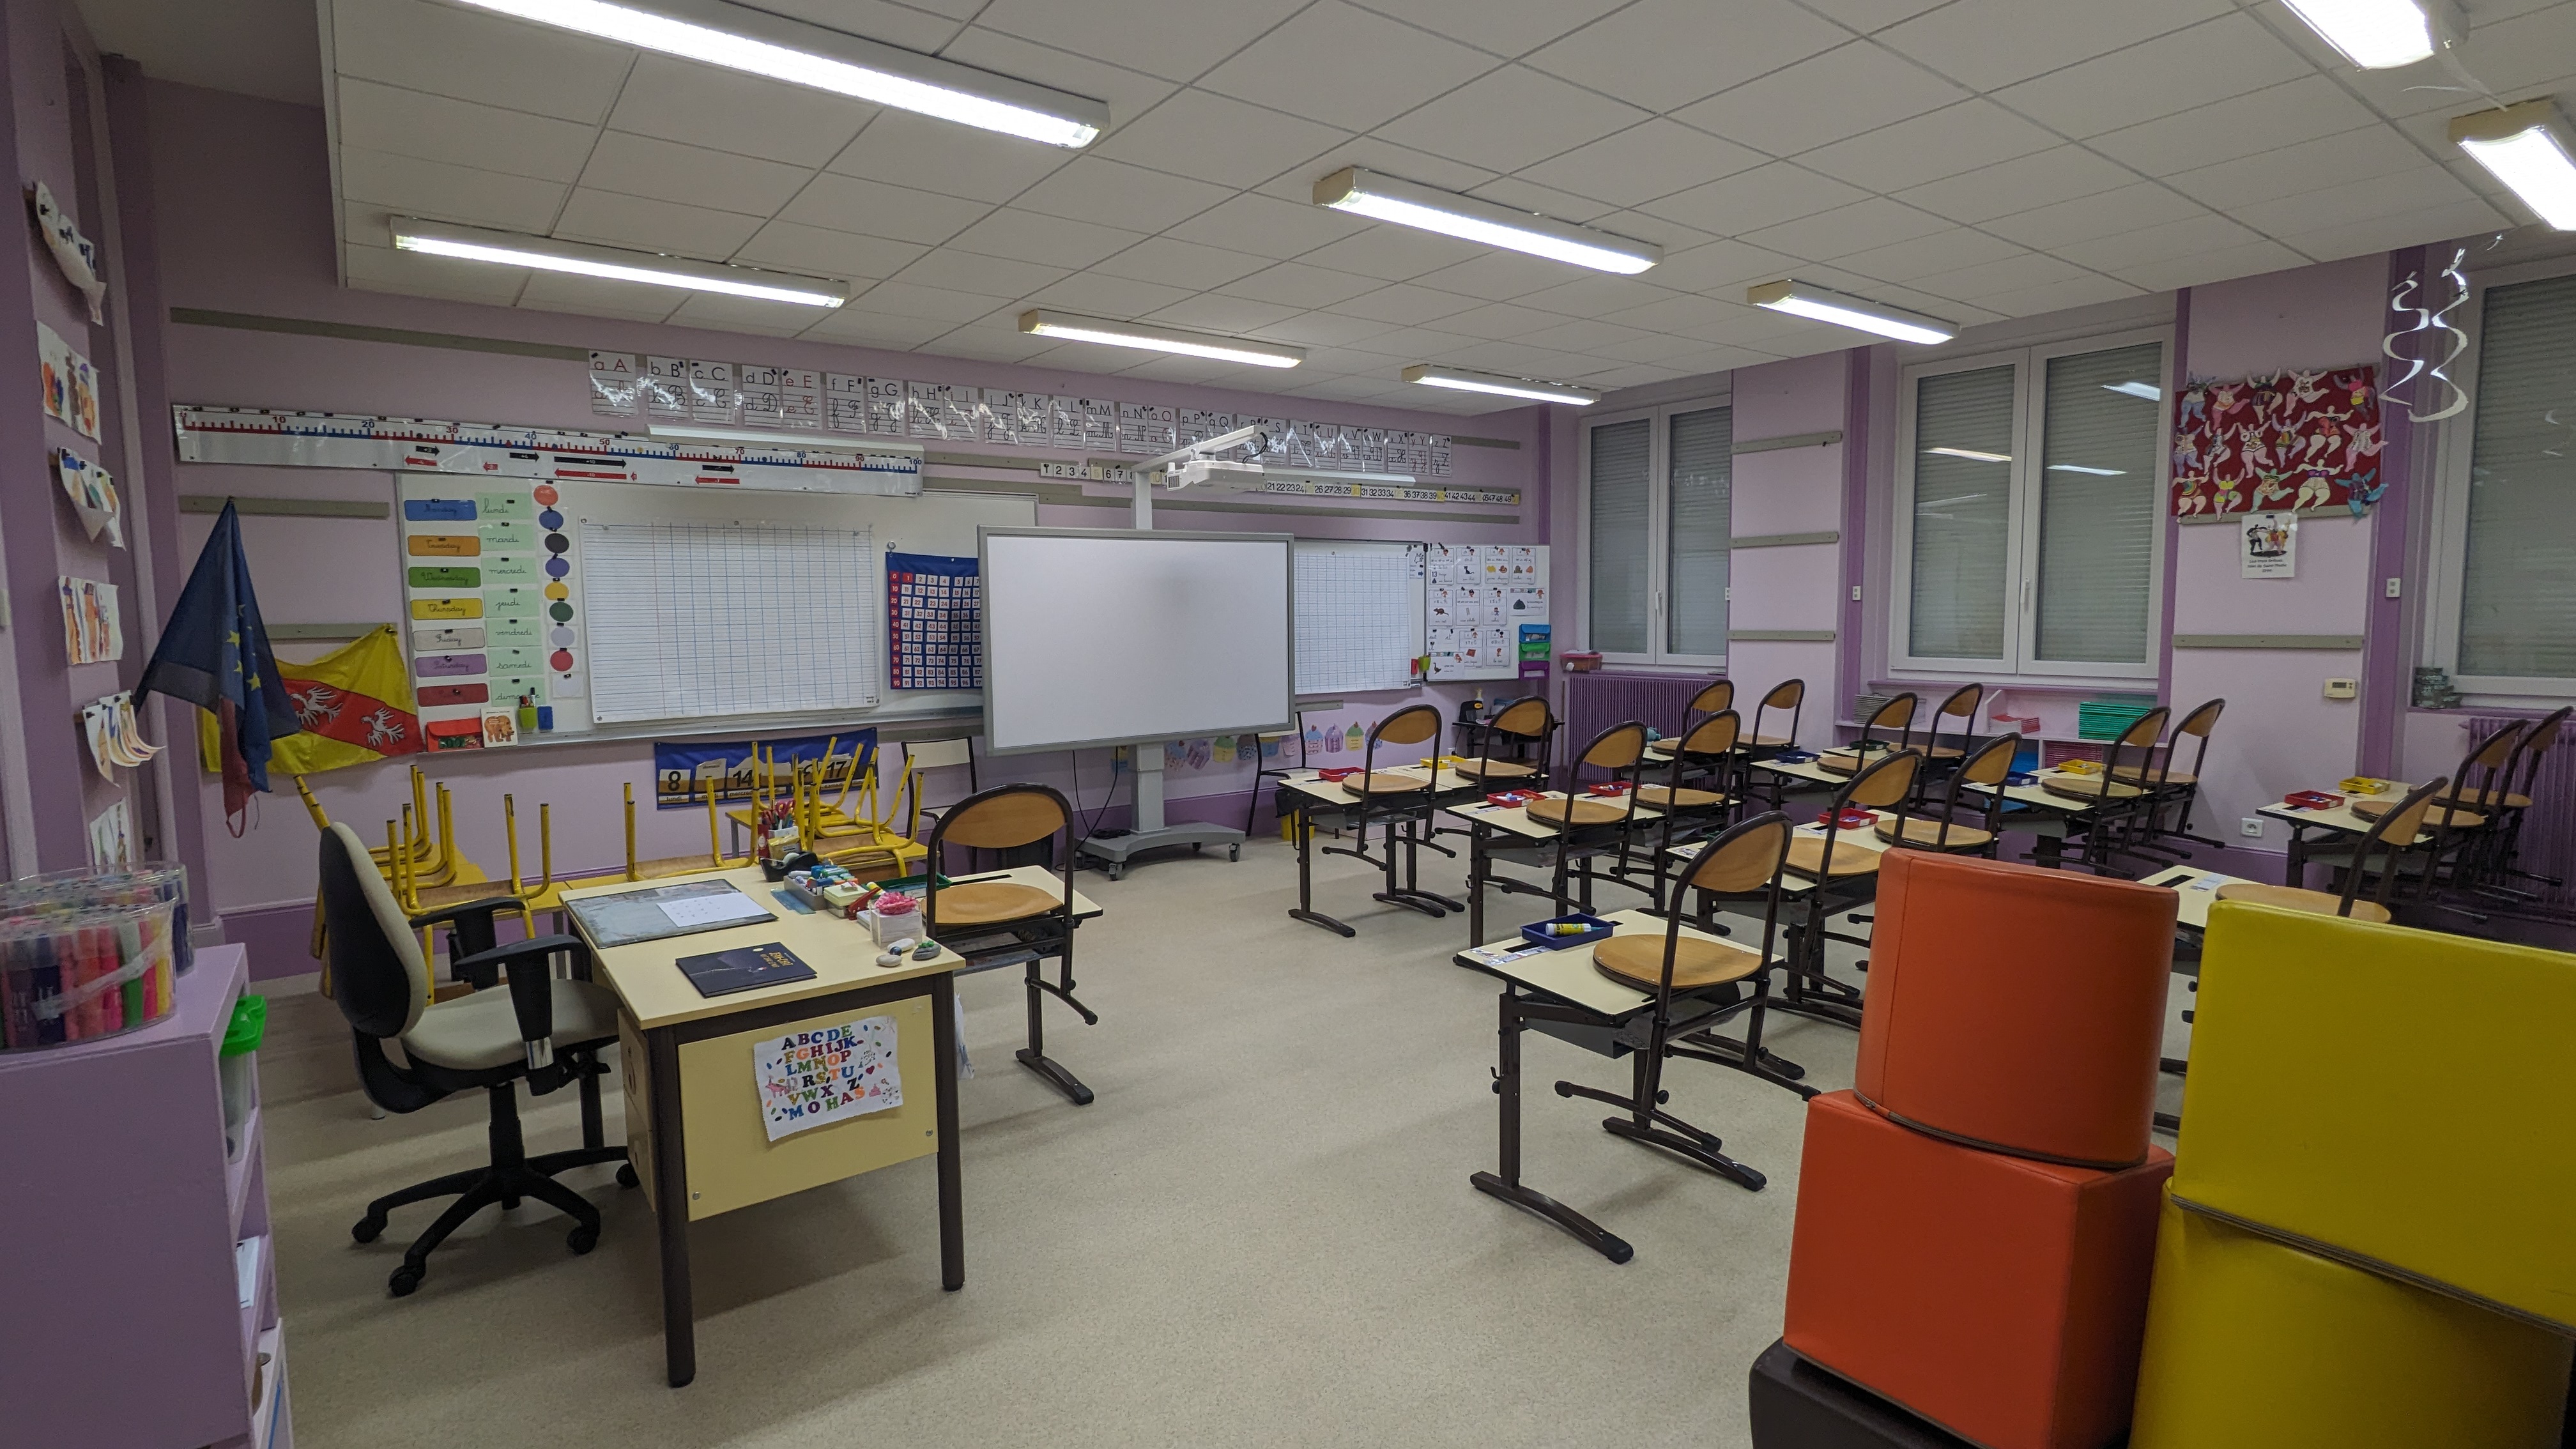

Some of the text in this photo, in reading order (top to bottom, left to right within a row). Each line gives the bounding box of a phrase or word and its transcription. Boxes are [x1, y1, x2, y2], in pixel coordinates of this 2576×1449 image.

[594, 358, 627, 372] a A
[651, 362, 680, 377] b B
[694, 367, 725, 381] c C
[747, 372, 774, 385] d D
[786, 375, 812, 388] e E
[832, 378, 855, 392] f F
[871, 383, 898, 398] g G
[912, 387, 936, 399] h H
[1002, 395, 1008, 406] J
[1034, 398, 1042, 409] K
[1070, 401, 1077, 412] L
[1100, 404, 1110, 415] M
[1135, 408, 1143, 419] N
[1162, 410, 1172, 422] O
[1183, 413, 1200, 425] p P
[1209, 416, 1229, 428] q Q
[1275, 422, 1281, 433] S
[1303, 425, 1307, 434] T
[1328, 427, 1333, 437] U
[1352, 431, 1358, 440] V
[1372, 432, 1381, 441] W
[1399, 434, 1404, 443] X
[1420, 436, 1425, 445] Y
[1443, 438, 1447, 447] Z
[1056, 466, 1062, 475] 2
[1070, 468, 1075, 476] 3
[1080, 468, 1086, 477] 4
[1106, 470, 1111, 479] 6
[1118, 471, 1123, 479] 7
[1296, 484, 1304, 493] 24
[483, 498, 509, 514] lundi
[486, 534, 519, 543] mardi
[489, 565, 527, 574] mercredi
[428, 604, 466, 616] Thursday
[495, 598, 521, 611] jeudi
[435, 634, 462, 647] Friday
[496, 661, 532, 670] samedi
[827, 761, 847, 778] 17
[668, 770, 681, 792] 8
[733, 769, 753, 788] 14
